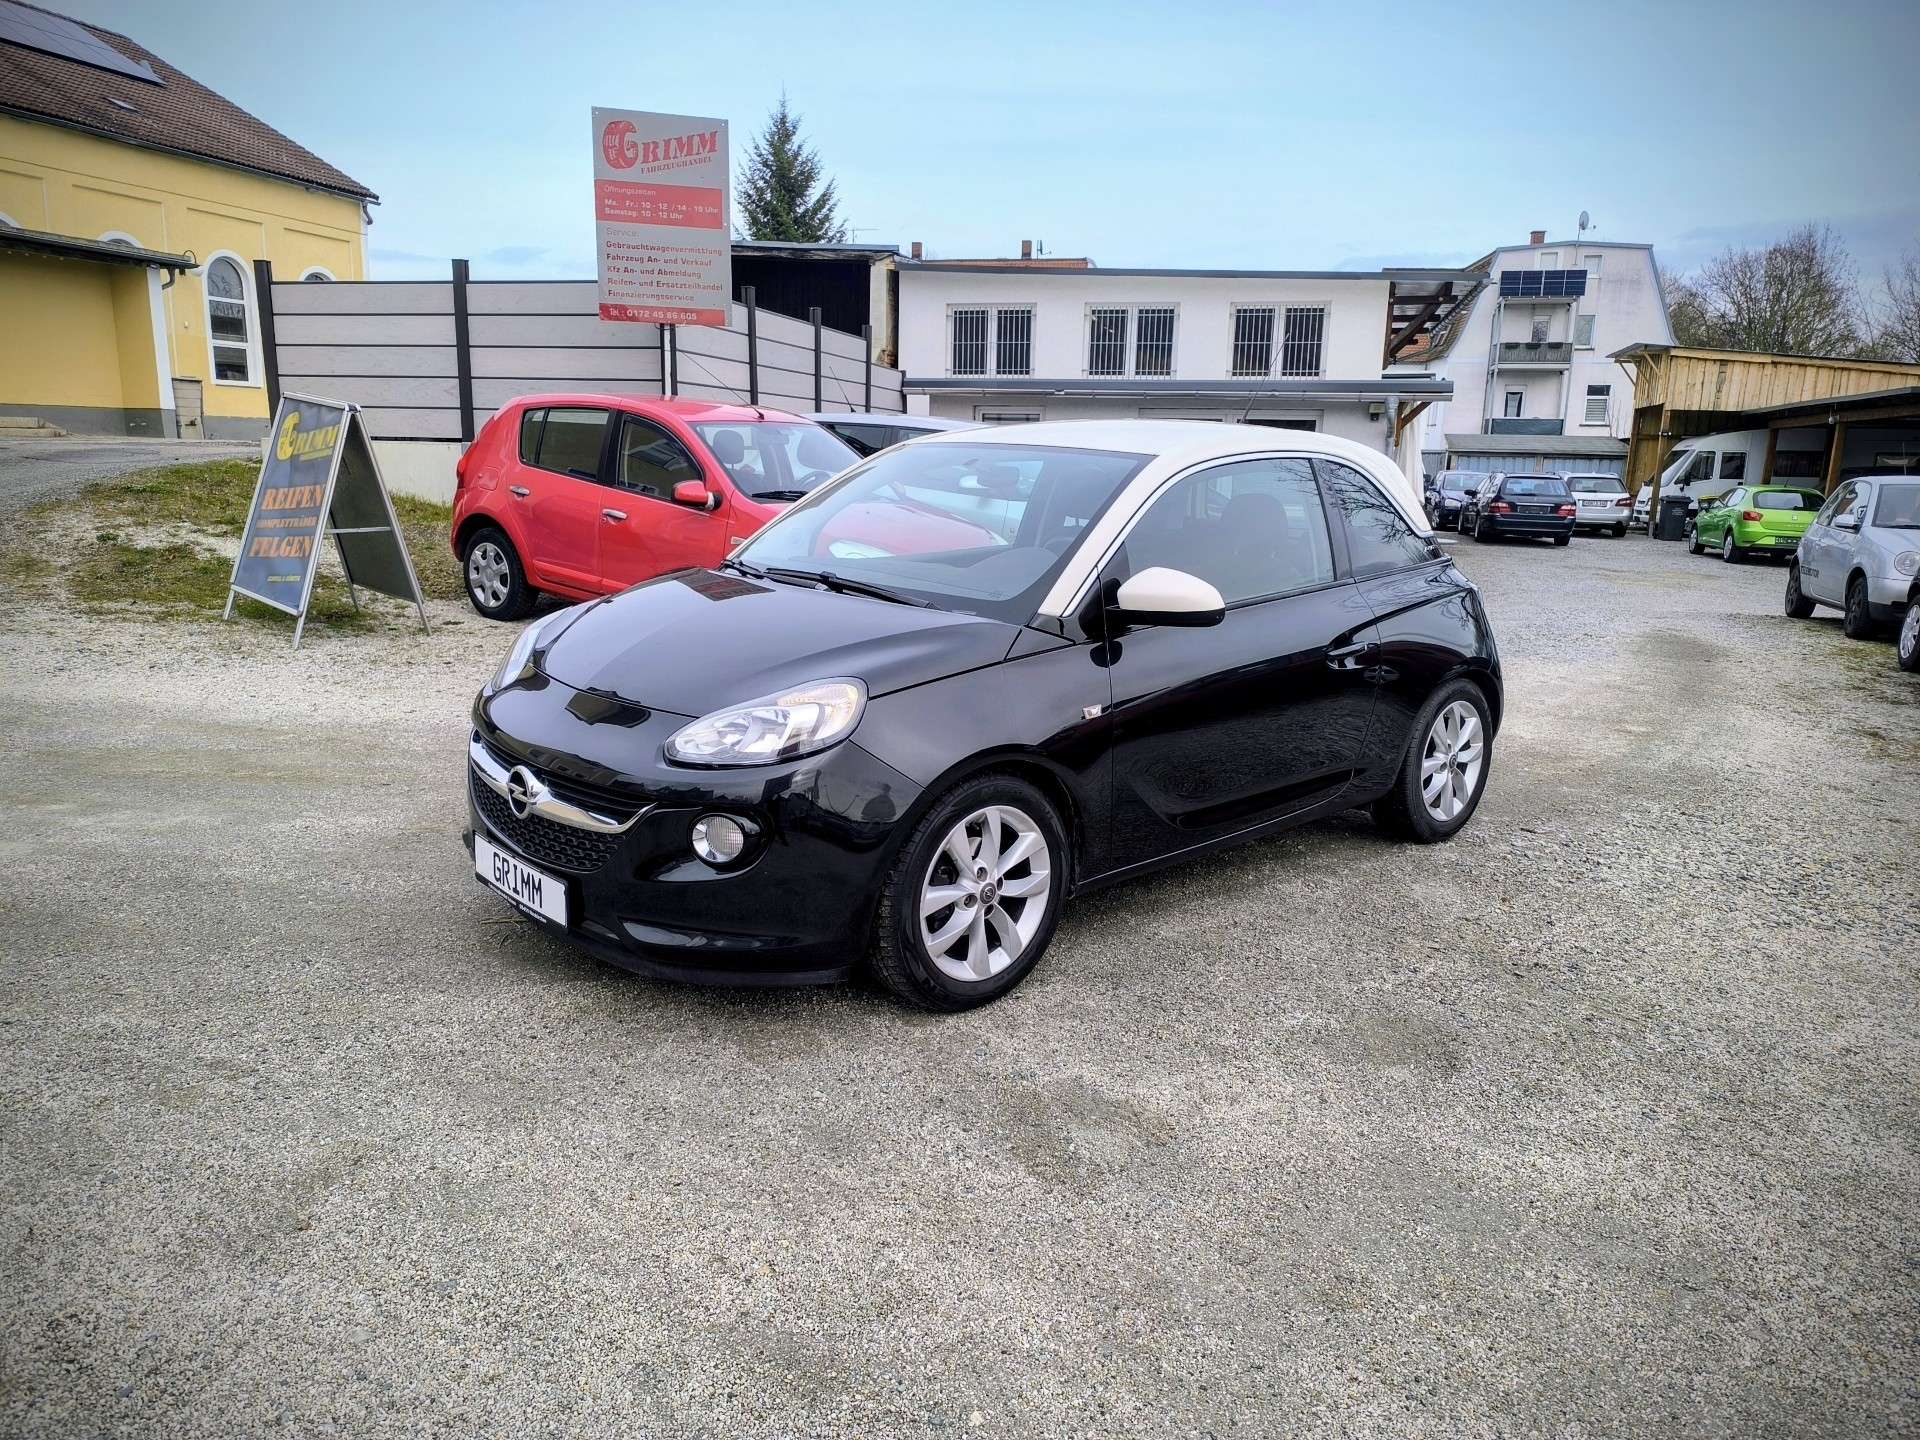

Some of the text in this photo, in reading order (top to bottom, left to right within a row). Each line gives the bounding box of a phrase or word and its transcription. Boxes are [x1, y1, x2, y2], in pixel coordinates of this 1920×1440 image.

[603, 120, 718, 170] GRIMM
[641, 156, 712, 175] FAHRZEUGHANDEL
[641, 201, 651, 209] 10
[658, 202, 668, 210] 12
[705, 206, 719, 214] Uhr
[641, 210, 651, 218] 10
[659, 211, 668, 219] 12
[670, 212, 683, 220] Uhr
[606, 240, 723, 257] Gebrauchtwagenvermittlung
[606, 253, 712, 267] Fahrzeug An- und Verkauf
[623, 266, 638, 274] An-
[640, 267, 655, 275] und
[657, 268, 702, 279] Abmeldung
[638, 279, 654, 288] und
[656, 280, 723, 291] Ersatzteilhandel
[608, 289, 695, 301] Finanzierungsservice
[626, 309, 650, 318] 0172
[652, 310, 664, 319] 45
[261, 484, 327, 510] REIFEN
[248, 536, 315, 558] FELGEN
[493, 851, 543, 909] GRIMM
